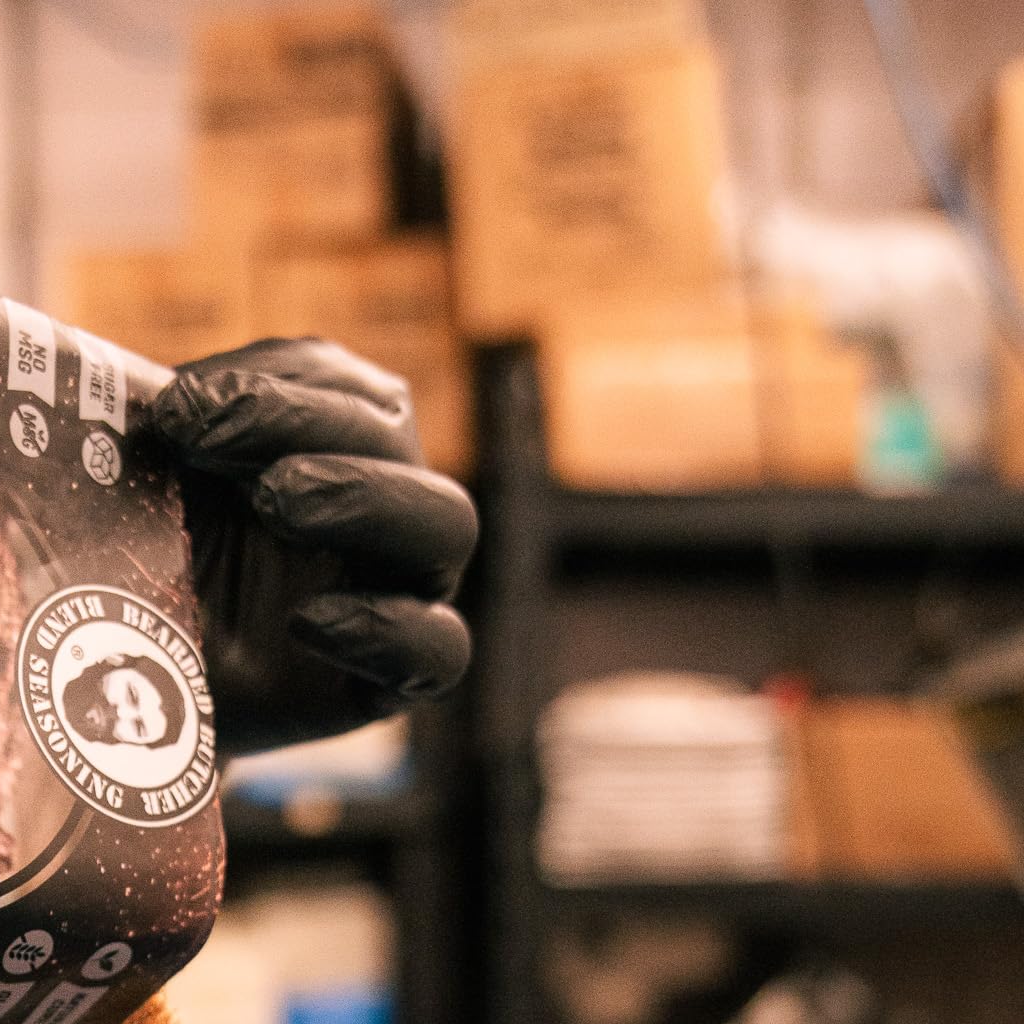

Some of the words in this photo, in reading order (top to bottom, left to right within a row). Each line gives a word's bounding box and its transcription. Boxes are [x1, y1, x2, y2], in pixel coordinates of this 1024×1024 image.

[18, 330, 33, 375] MSG
[33, 343, 47, 374] NO
[36, 595, 105, 650] BLEND
[123, 602, 215, 715] BEARDED
[28, 654, 124, 809] SEASONING
[140, 723, 216, 816] BUTCHER
